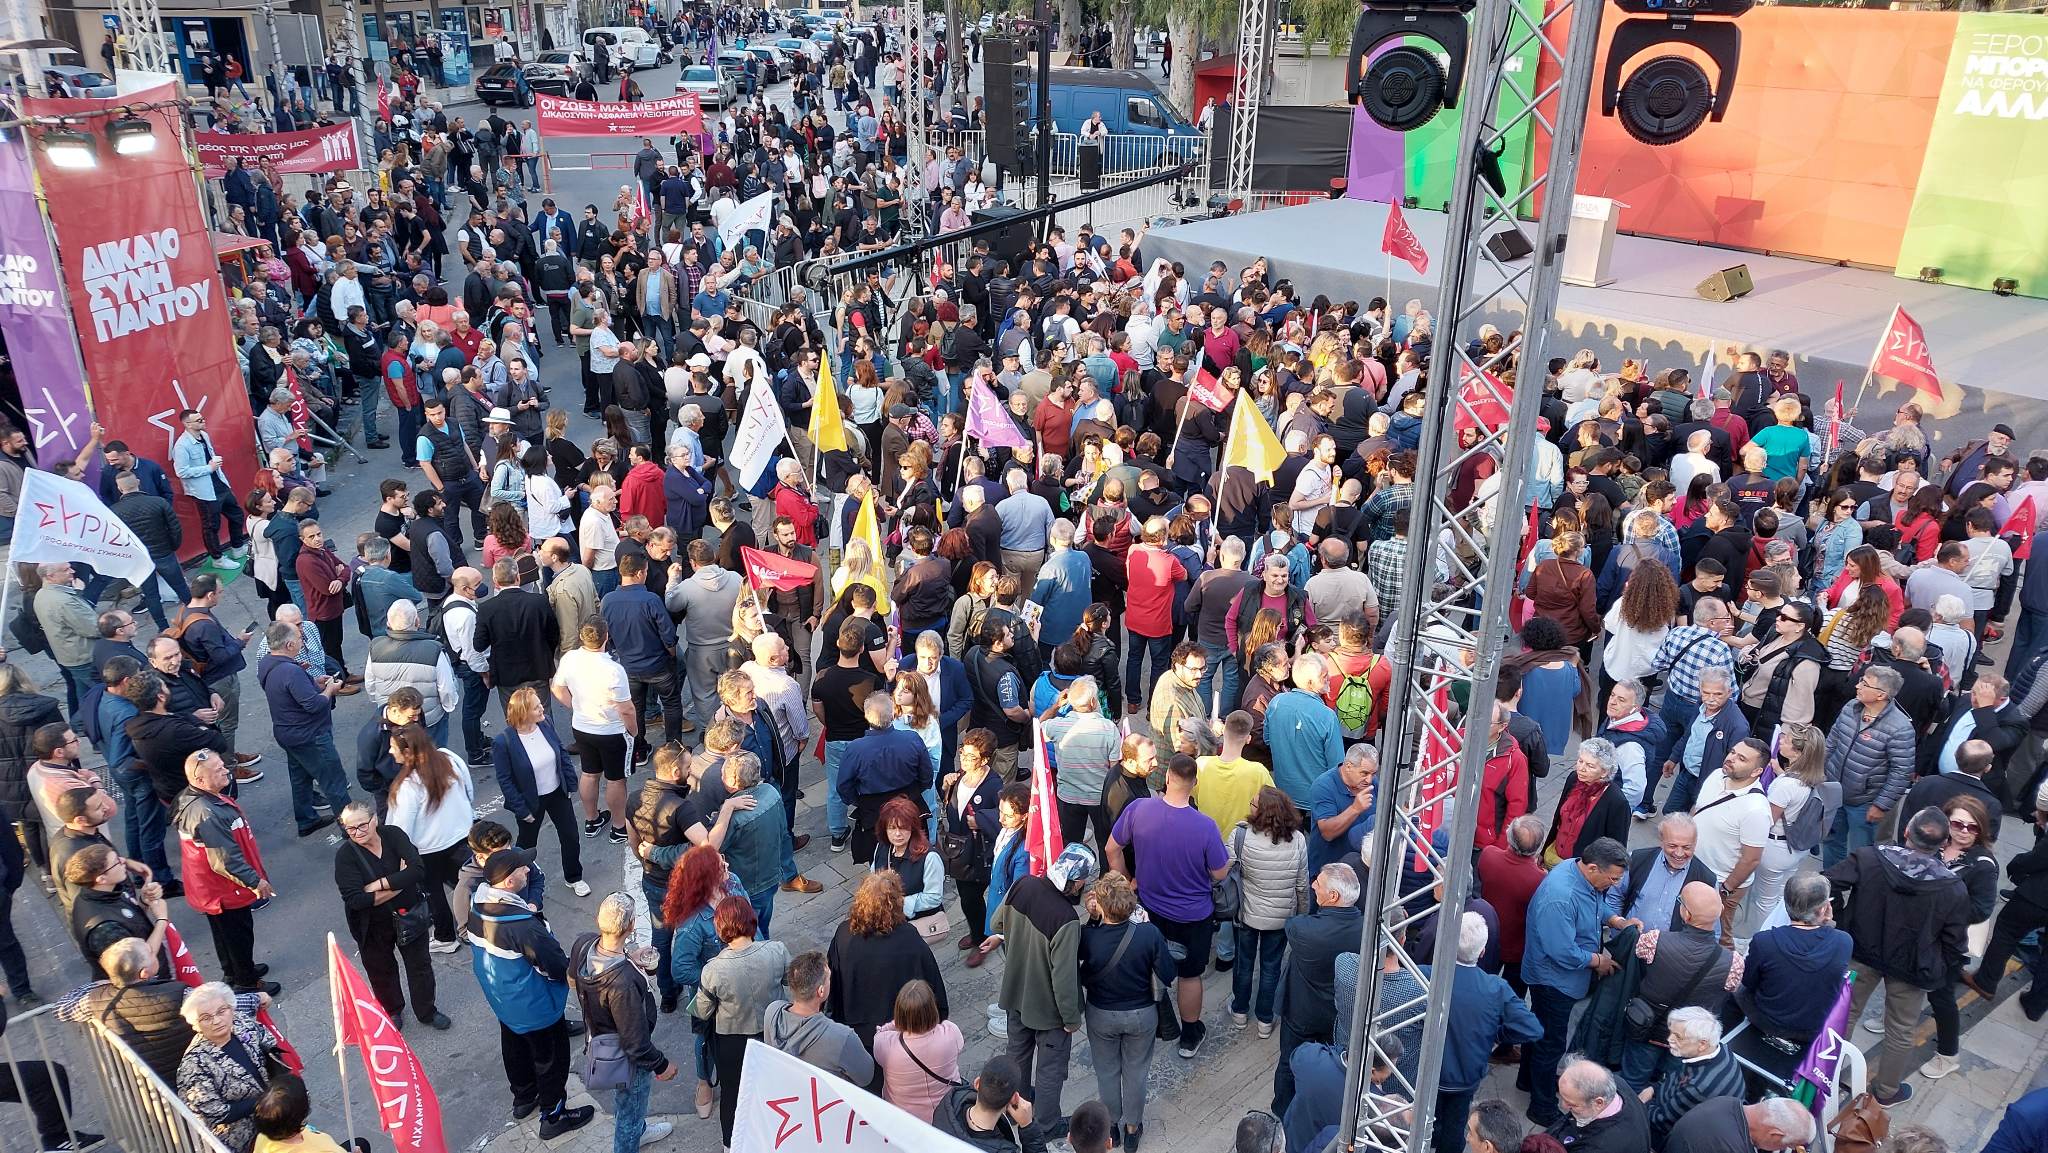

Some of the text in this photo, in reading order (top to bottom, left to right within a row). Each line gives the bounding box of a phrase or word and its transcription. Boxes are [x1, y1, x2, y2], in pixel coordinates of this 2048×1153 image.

[1961, 75, 2048, 92] ΝΑ ΦΕΡΟΥ
[540, 100, 557, 110] ΟΙ
[560, 101, 596, 112] ΖΩΕΣ
[600, 104, 629, 113] ΜΑΣ
[542, 111, 593, 119] ΔΙΚΑΙΟΣΥΝΗ
[598, 111, 639, 119] ΑΣΦΑΛΕΙΑ
[197, 142, 226, 153] ρέος
[82, 227, 180, 282] ΔΙΚΑΙΟ
[84, 261, 174, 313] ΣΥΝΗ
[91, 278, 210, 343] ΠΑΝΤΟΥ
